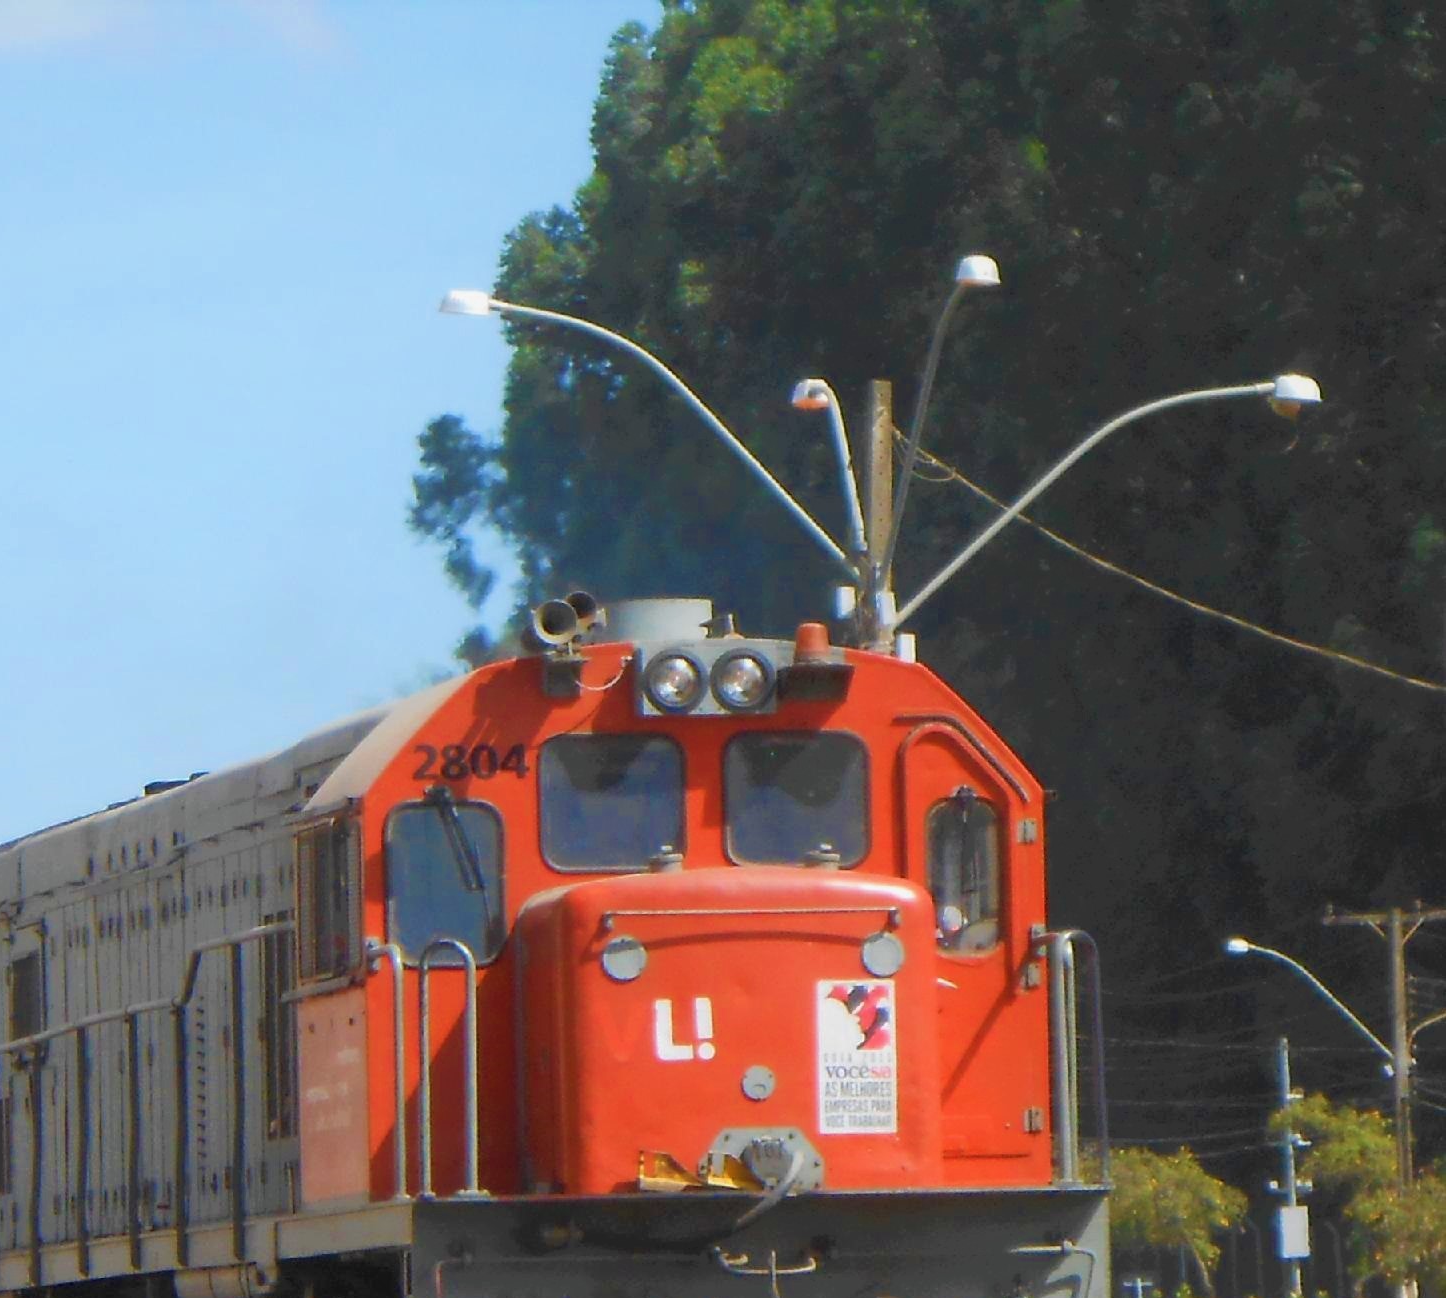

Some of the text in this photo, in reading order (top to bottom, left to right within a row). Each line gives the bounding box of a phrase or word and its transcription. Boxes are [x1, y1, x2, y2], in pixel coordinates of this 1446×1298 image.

[412, 743, 530, 780] 2804
[654, 996, 717, 1061] L!
[825, 1081, 892, 1097] AS MELHORES
